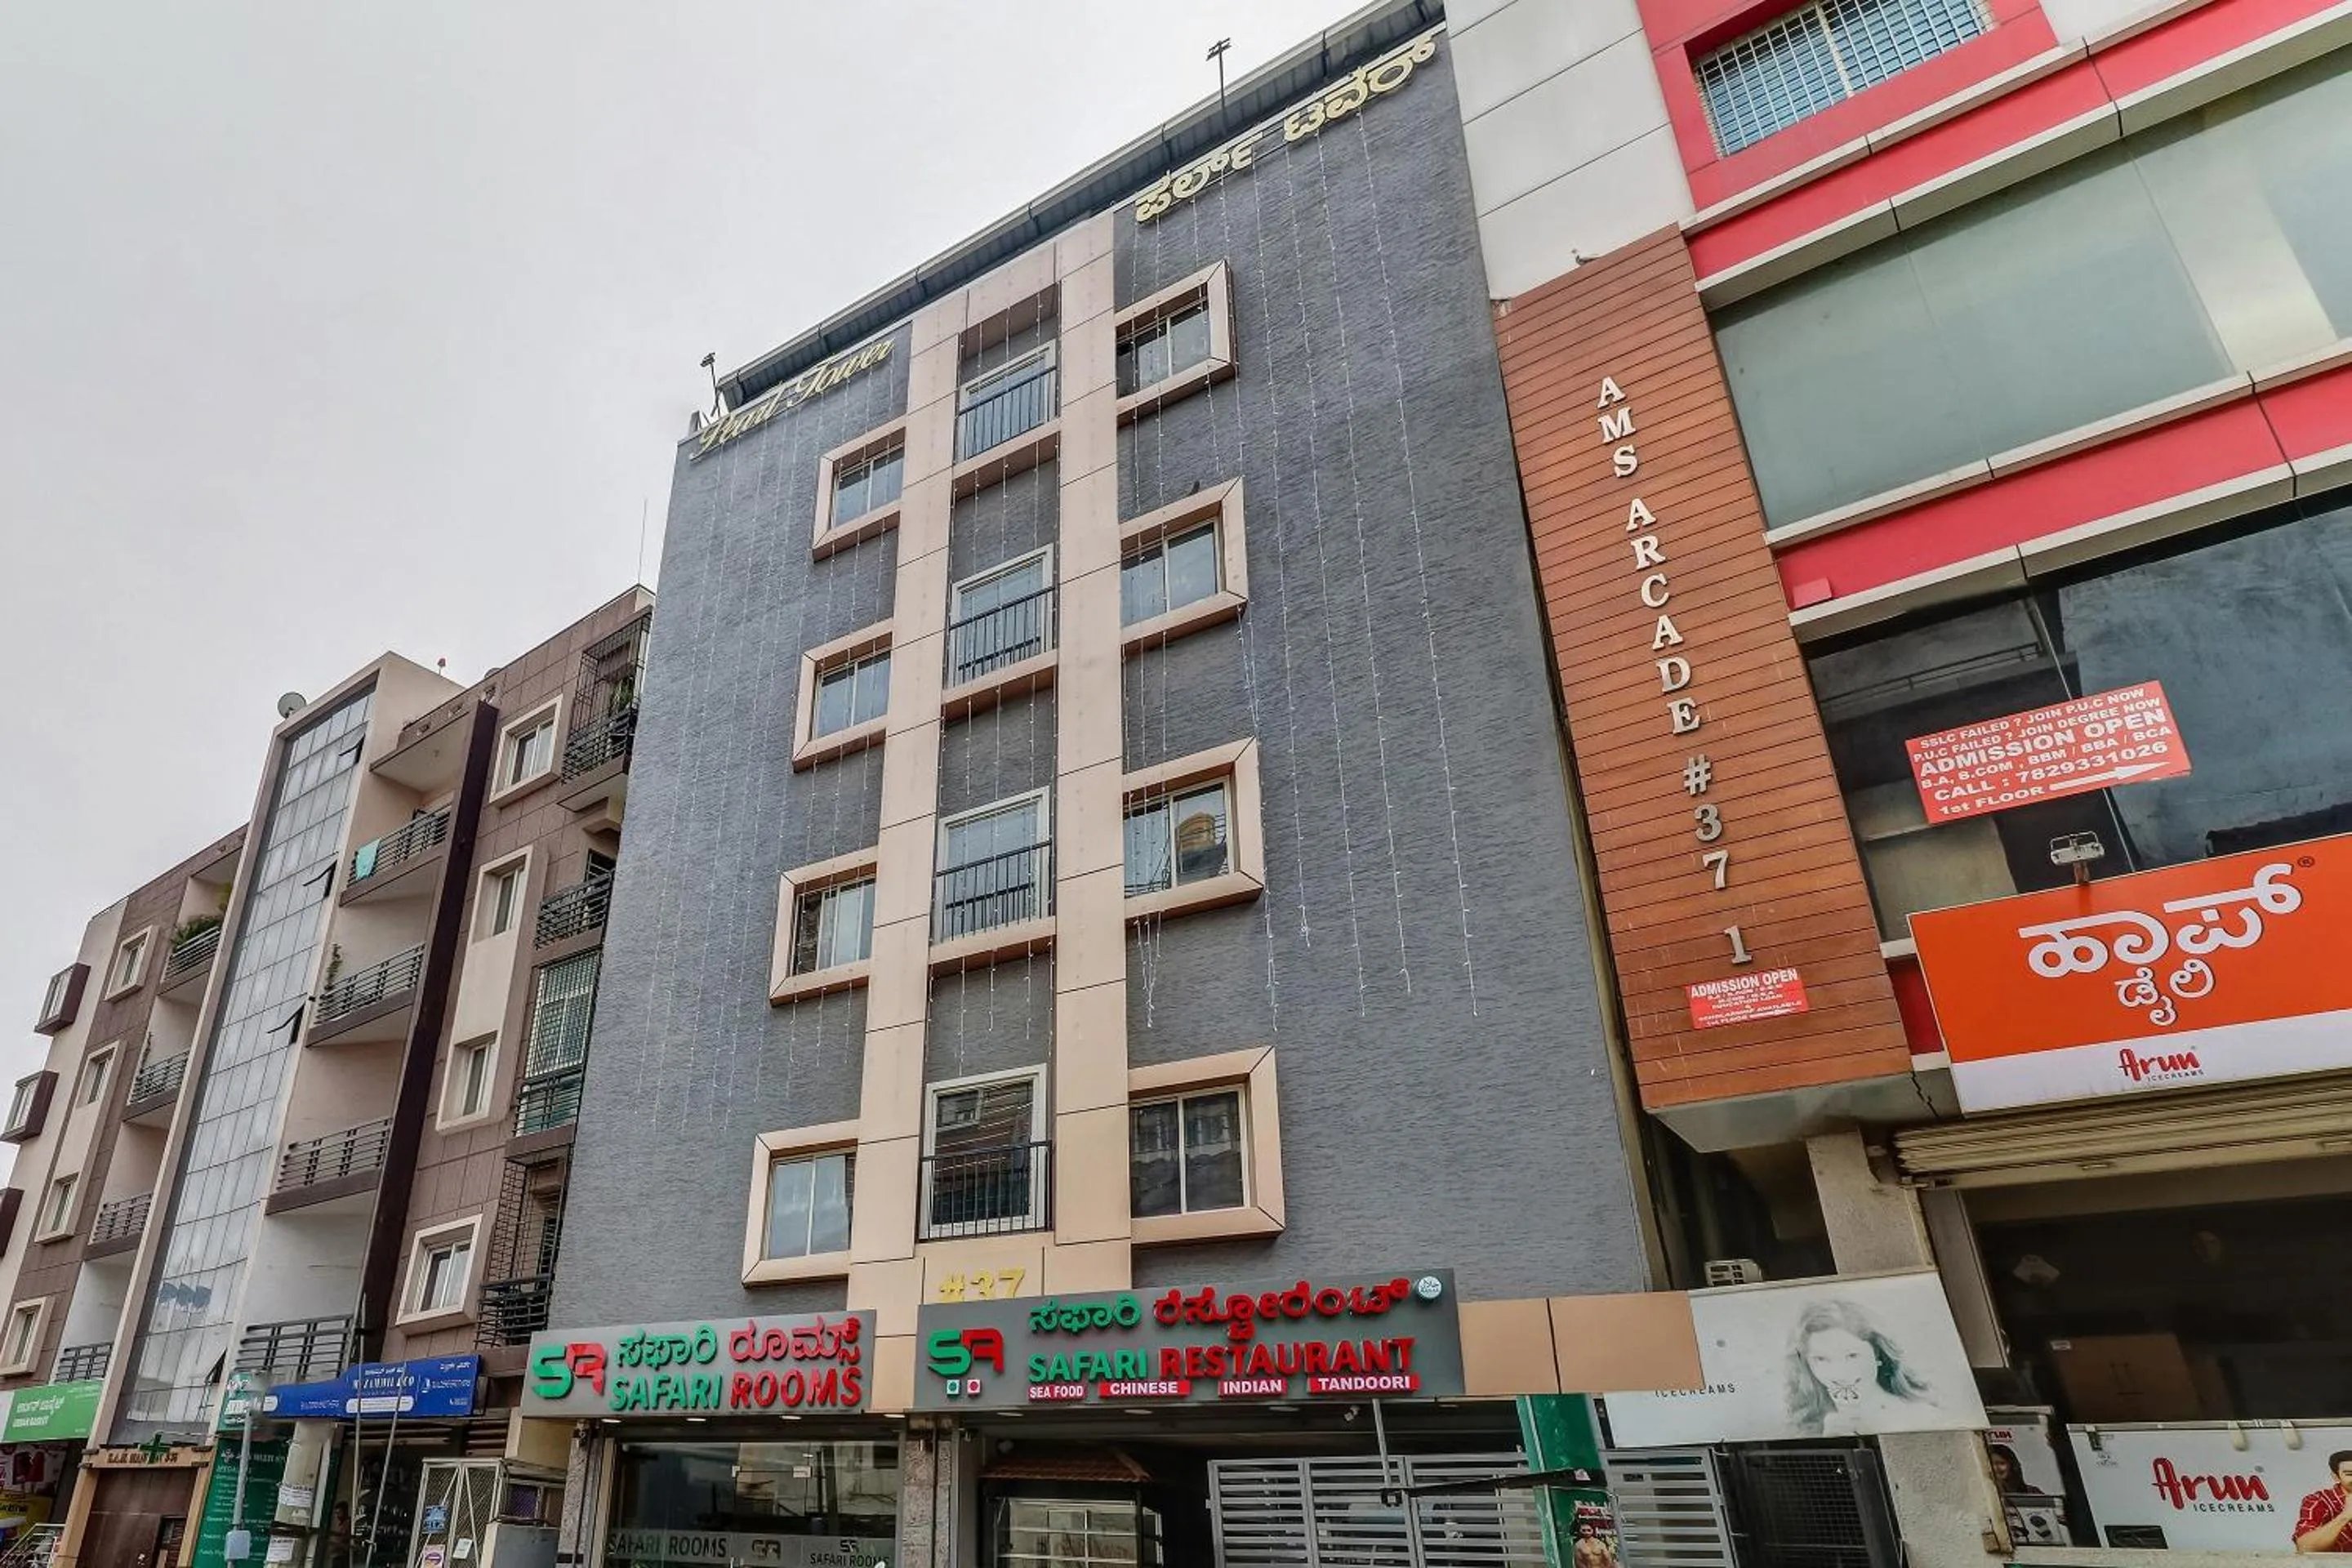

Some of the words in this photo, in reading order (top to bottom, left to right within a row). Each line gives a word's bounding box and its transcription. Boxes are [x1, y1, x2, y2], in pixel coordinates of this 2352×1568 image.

[1597, 376, 1637, 478] AMS
[1625, 497, 1702, 735] ARCADE
[1913, 747, 1948, 763] P.U.C
[1952, 735, 2001, 755] FAILED
[2017, 722, 2053, 738] JOIN
[2057, 707, 2120, 729] DEGREE
[2123, 697, 2160, 714] NOW
[1920, 733, 1957, 749] SSLC
[1959, 719, 2010, 739] FAILED
[2027, 709, 2062, 724] JOIN
[2065, 698, 2104, 715] P.U.C
[2106, 688, 2145, 705] NOW
[1920, 728, 2076, 777] ADMISSION
[2083, 708, 2166, 738] OPEN
[1958, 760, 2014, 782] B.COM
[2027, 748, 2067, 765] BBM
[2081, 737, 2119, 753] BBA
[2132, 726, 2172, 742] BCA
[1934, 780, 1997, 801] CALL
[2015, 741, 2168, 784] 7829331026
[1939, 802, 1971, 815] 1st
[1975, 786, 2046, 808] FLOOR
[1691, 974, 1760, 998] ADMISSION
[1762, 967, 1798, 985] OPEN
[2114, 959, 2216, 1027] ಡೈಲಿ
[2118, 1048, 2200, 1081] Arun
[2148, 1069, 2204, 1081] ICECREAMS
[940, 1267, 1026, 1302] #37
[1028, 1293, 1142, 1335] ಸಫಾರಿ
[615, 1324, 719, 1373] ಸಫಾರಿ
[1028, 1347, 1148, 1383] SAFARI
[1158, 1337, 1416, 1379] RESTAURANT
[609, 1373, 723, 1413] SAFARI
[730, 1365, 862, 1409] ROOMS
[1029, 1385, 1051, 1400] SEA
[1054, 1384, 1085, 1398] FOOD
[1110, 1380, 1178, 1395] CHINESE
[1223, 1379, 1283, 1395] INDIAN
[1318, 1375, 1411, 1391] TANDOORI
[2152, 1457, 2270, 1510] Arun
[2193, 1503, 2274, 1512] ICECREAMS
[668, 1535, 728, 1558] ROOMS
[809, 1552, 847, 1566] SAFARI
